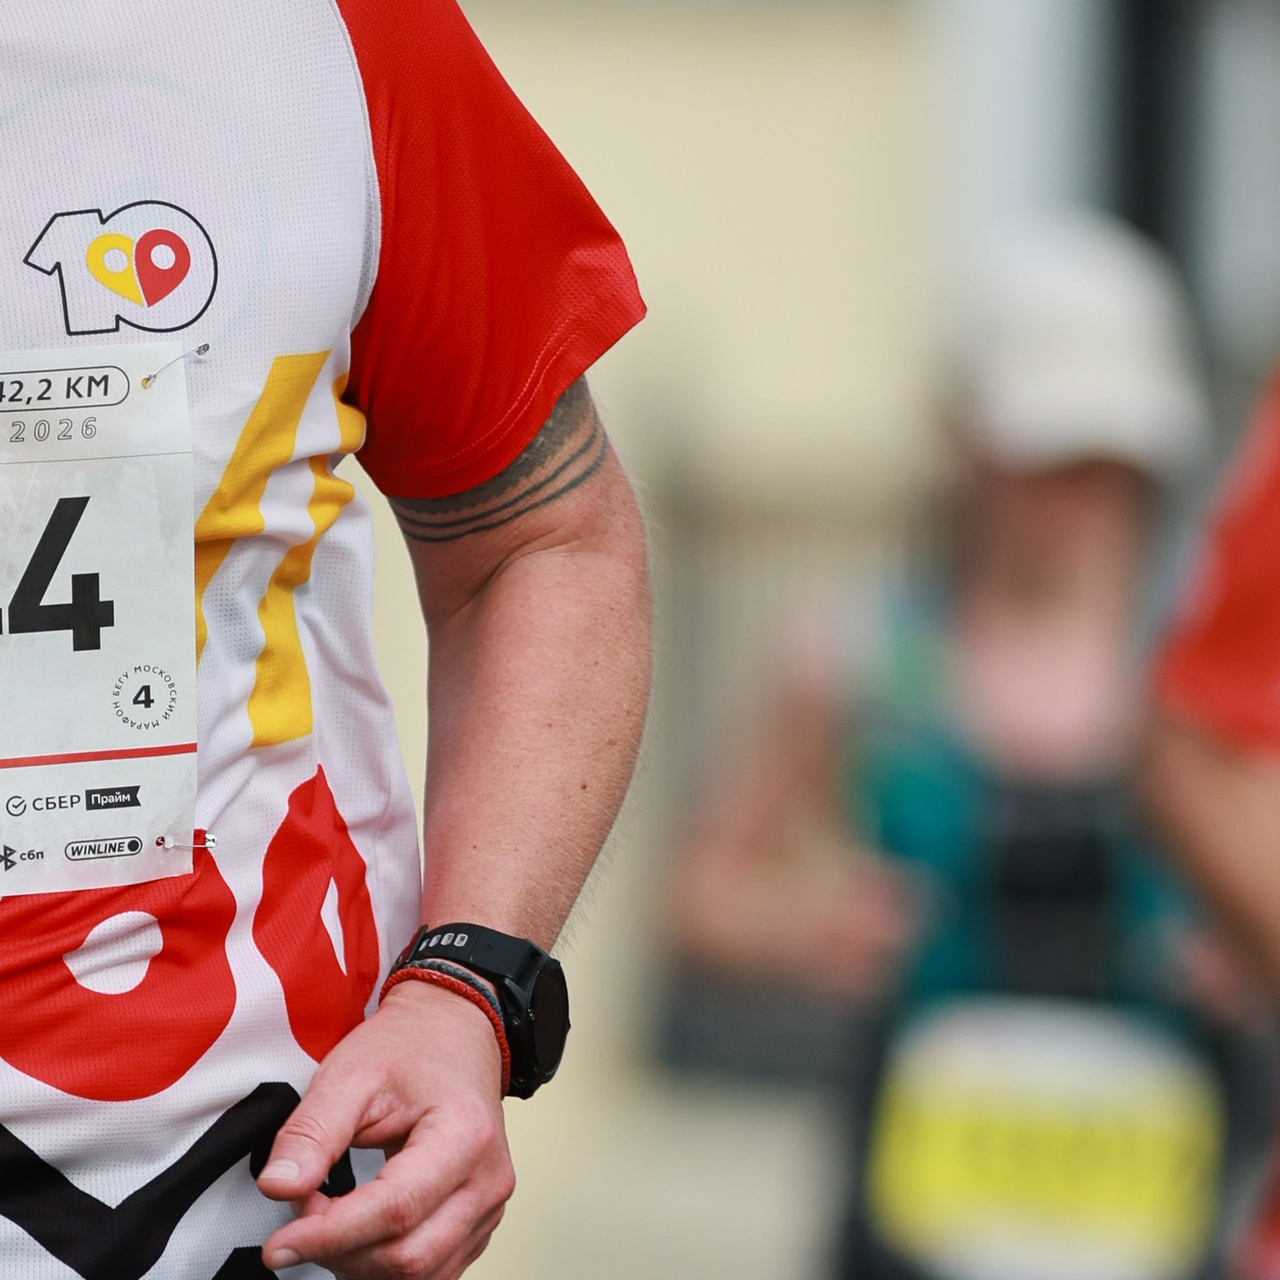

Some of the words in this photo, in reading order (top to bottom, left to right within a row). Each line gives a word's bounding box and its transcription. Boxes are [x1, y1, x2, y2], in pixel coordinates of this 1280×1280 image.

[65, 374, 110, 400] КМ
[9, 416, 98, 443] 2026
[112, 671, 129, 697] БЕГУ
[132, 684, 155, 709] 4
[133, 664, 177, 720] МОСКОВСКИЙ
[112, 701, 160, 730] МАРАФОН
[32, 794, 81, 811] СБЕР
[91, 791, 131, 806] Прайм
[70, 841, 126, 857] WINLINE
